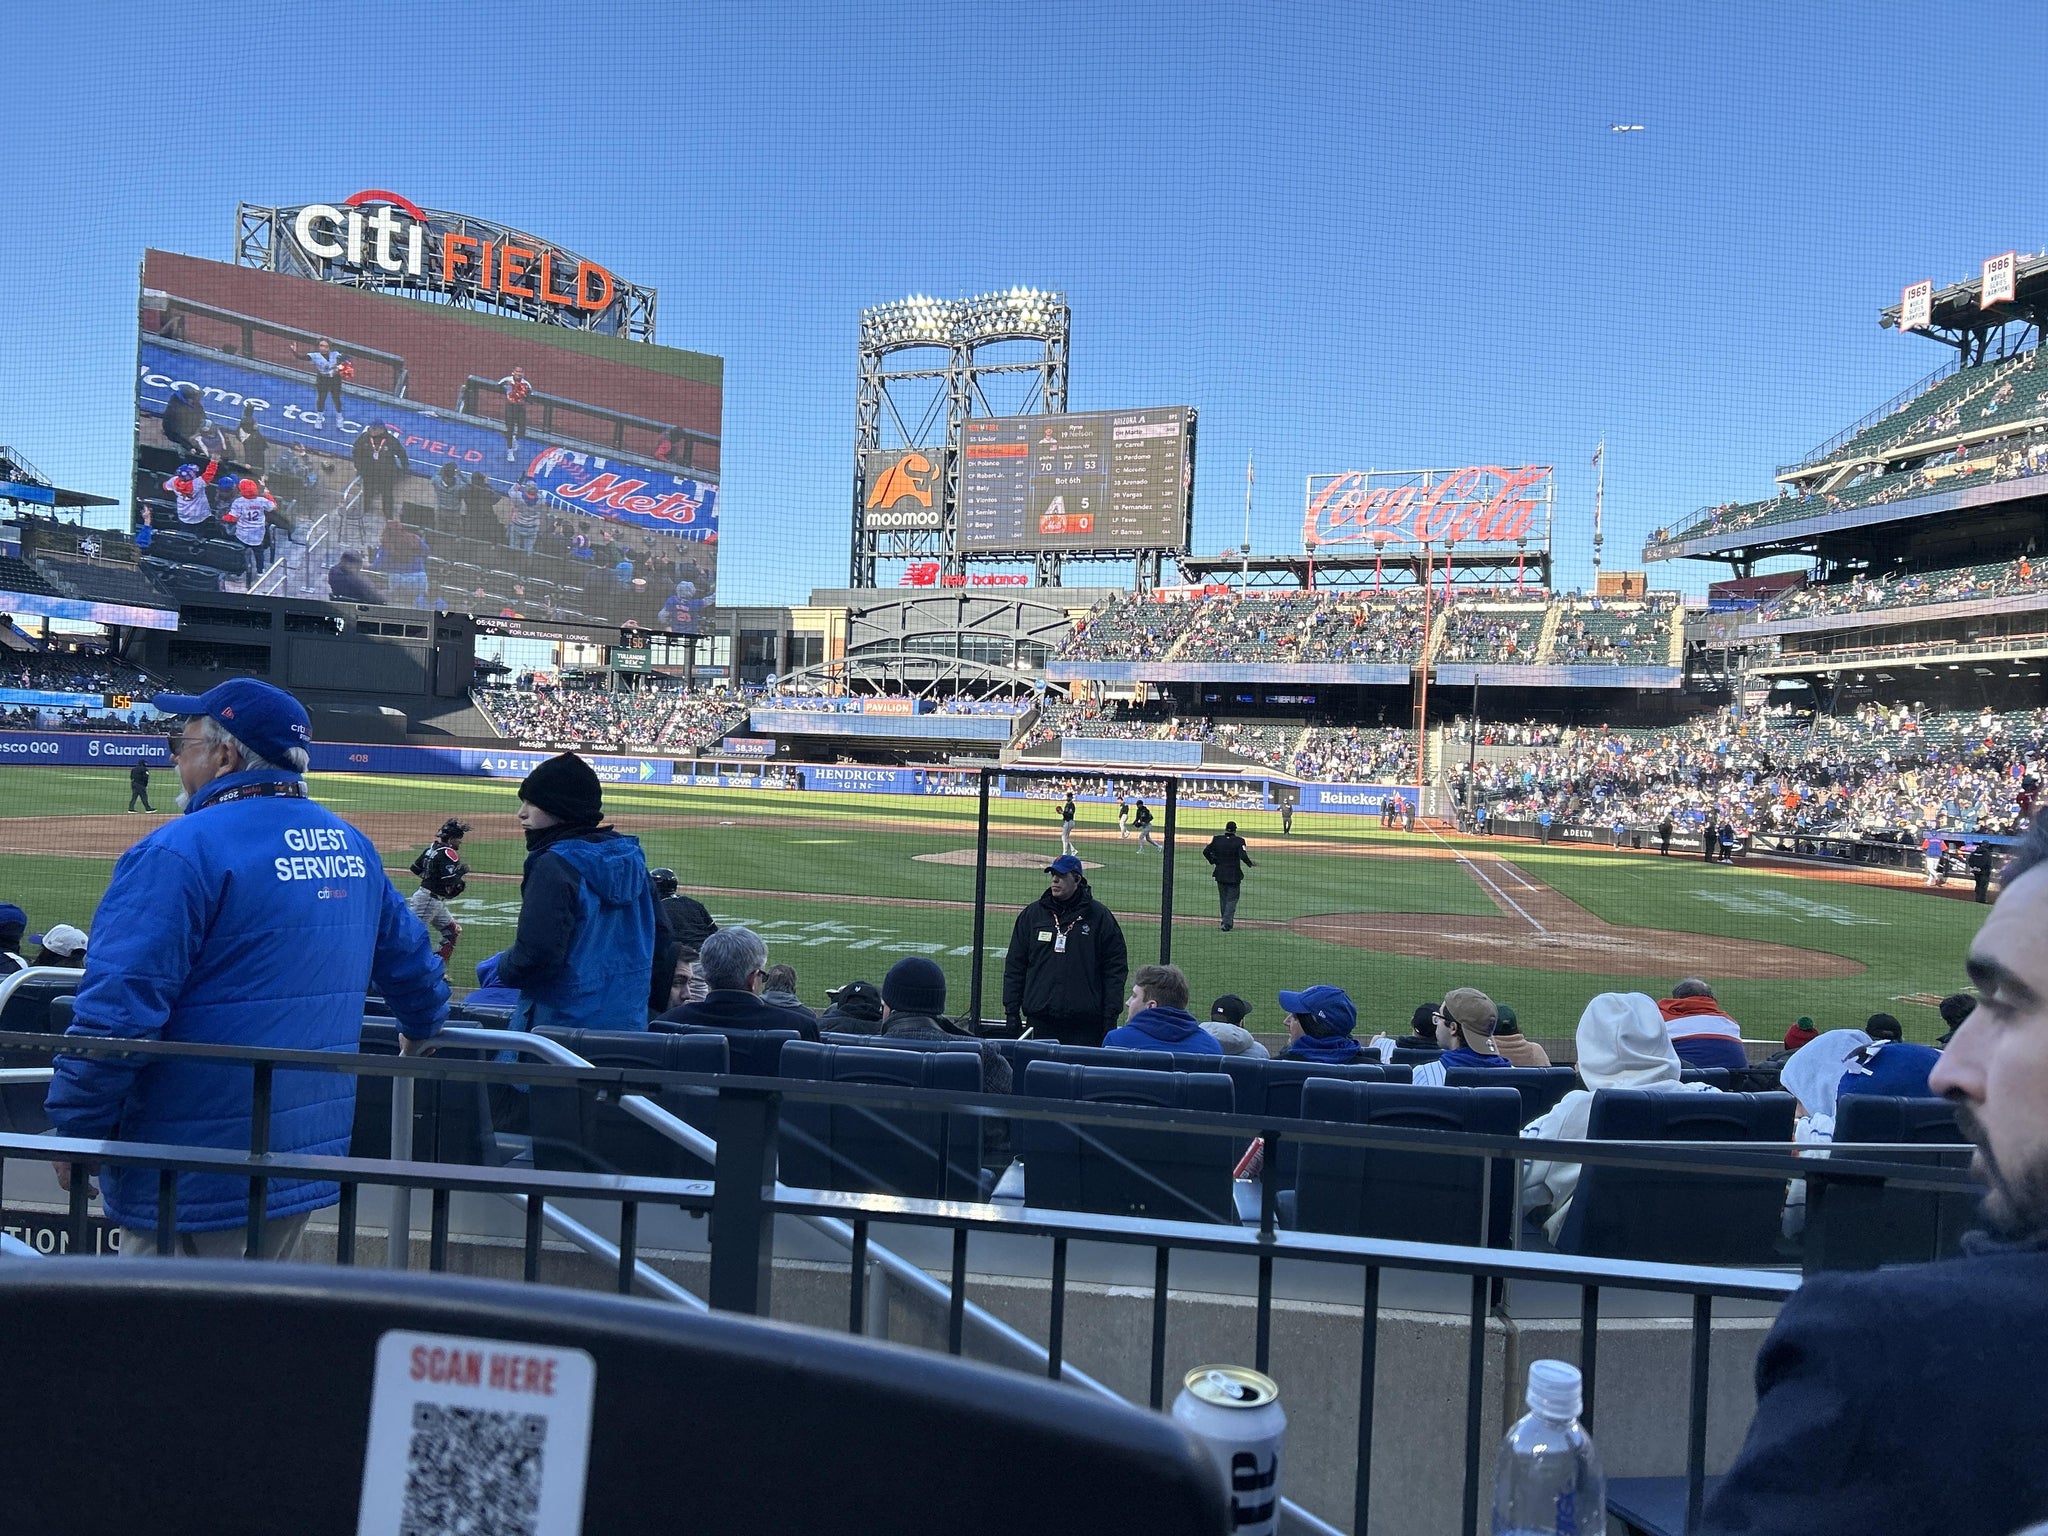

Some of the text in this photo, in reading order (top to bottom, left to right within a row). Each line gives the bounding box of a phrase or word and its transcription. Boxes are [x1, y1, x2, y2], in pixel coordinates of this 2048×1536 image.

[295, 203, 615, 311] citi FIELD
[1988, 257, 2009, 274] 1986
[1908, 285, 1928, 300] 1969
[1114, 416, 1137, 426] ARIZONA
[405, 435, 484, 462] FIELD
[1124, 440, 1144, 448] Carroll
[1040, 462, 1052, 472] 70
[1064, 462, 1073, 470] 17
[1084, 460, 1096, 470] 53
[1068, 476, 1081, 484] 6th
[556, 472, 702, 524] Mets
[1122, 492, 1142, 500] Vargas
[1081, 497, 1090, 510] 5
[1304, 464, 1553, 546] Coca-Cola
[866, 511, 939, 527] moomoo
[1079, 517, 1089, 529] 0
[972, 573, 1028, 586] balance
[536, 631, 563, 639] TEACHER
[112, 695, 132, 709] 1:56
[866, 703, 909, 712] PAVILION
[30, 742, 59, 754] QQQ
[104, 743, 166, 757] Guardian
[735, 744, 764, 753] $8,360
[349, 754, 368, 763] 408
[594, 765, 638, 774] HAUGLAND
[671, 774, 688, 784] 380
[696, 776, 719, 784] GOYA
[815, 769, 896, 782] HENDRICK'S
[728, 777, 752, 786] GOYA
[760, 778, 784, 787] GOYA
[844, 782, 868, 790] GIN
[1208, 802, 1265, 811] CADILLAC
[1570, 828, 1593, 838] DELTA
[284, 828, 349, 852] GUEST
[274, 855, 366, 882] SERVICES
[410, 1344, 558, 1398] SCAN HERE
